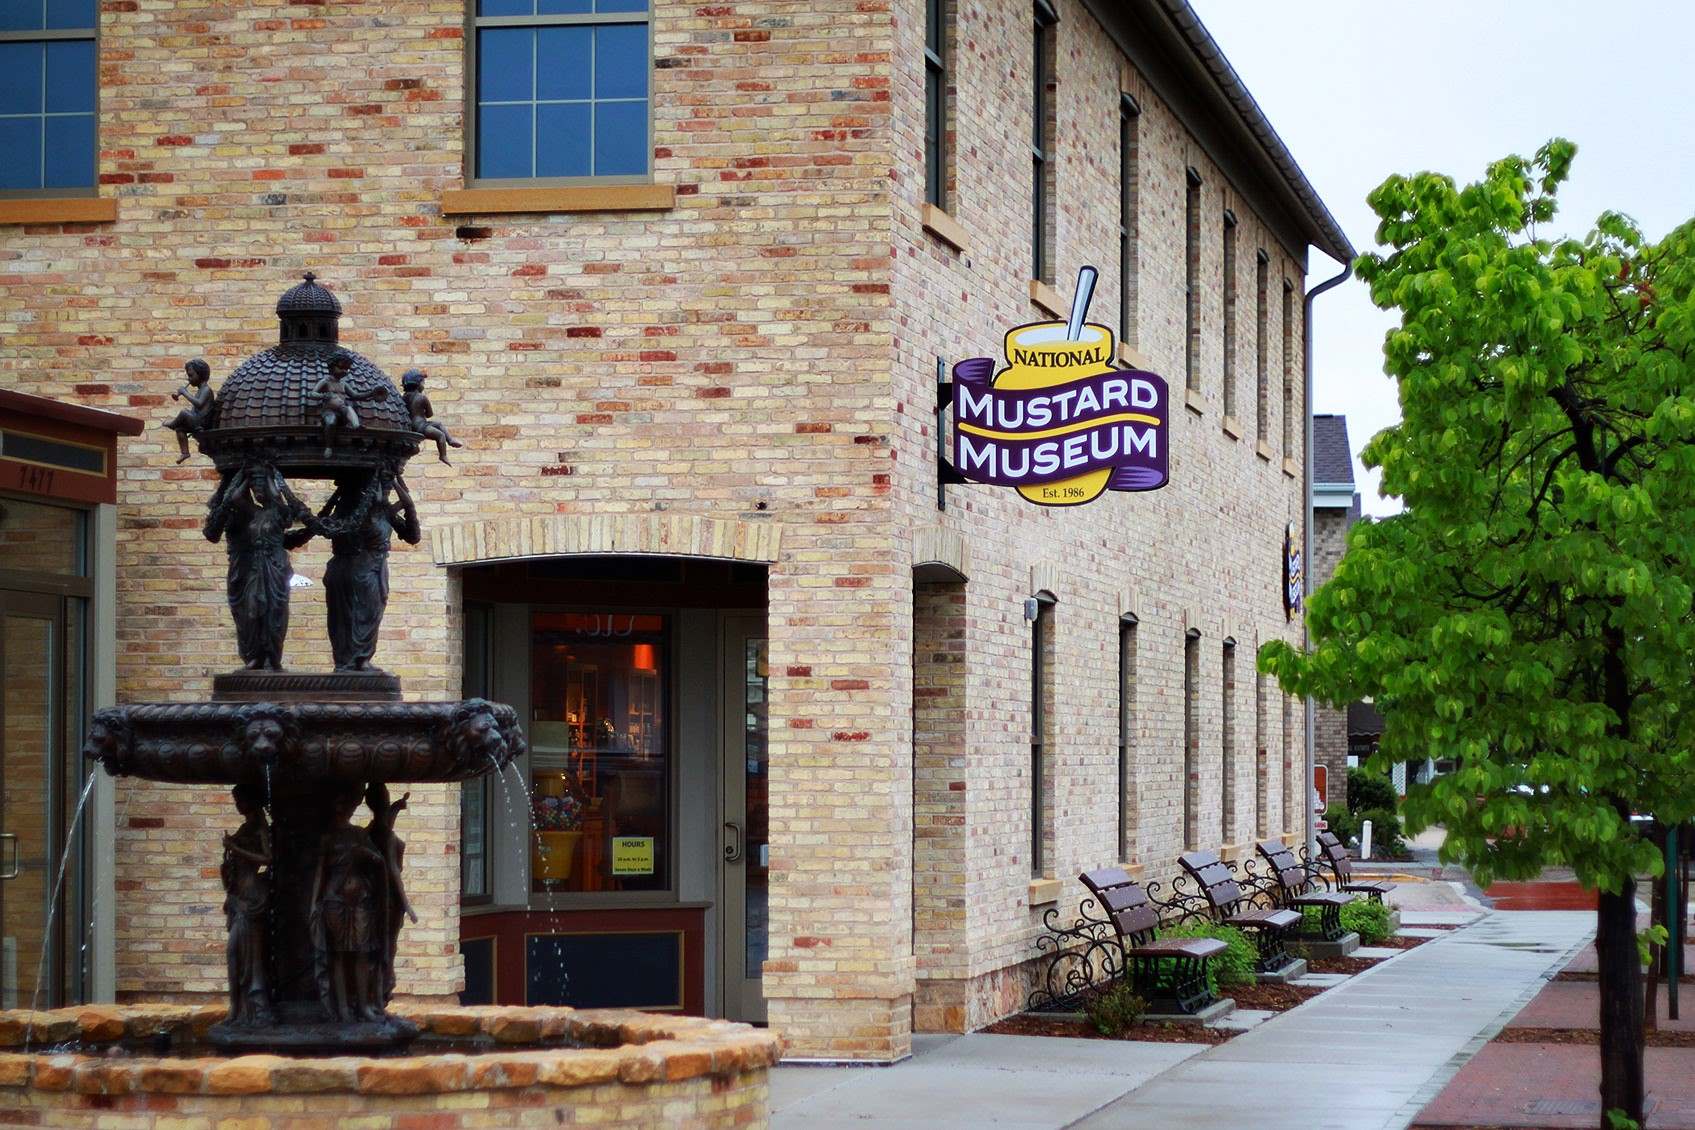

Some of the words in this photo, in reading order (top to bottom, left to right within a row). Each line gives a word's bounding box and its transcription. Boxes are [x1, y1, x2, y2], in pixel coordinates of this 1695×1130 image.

[1014, 347, 1105, 368] NATIONAL
[959, 378, 1159, 429] MUSTARD
[959, 426, 1157, 478] MUSEUM
[1042, 487, 1061, 499] Est.
[1063, 487, 1085, 499] 1986
